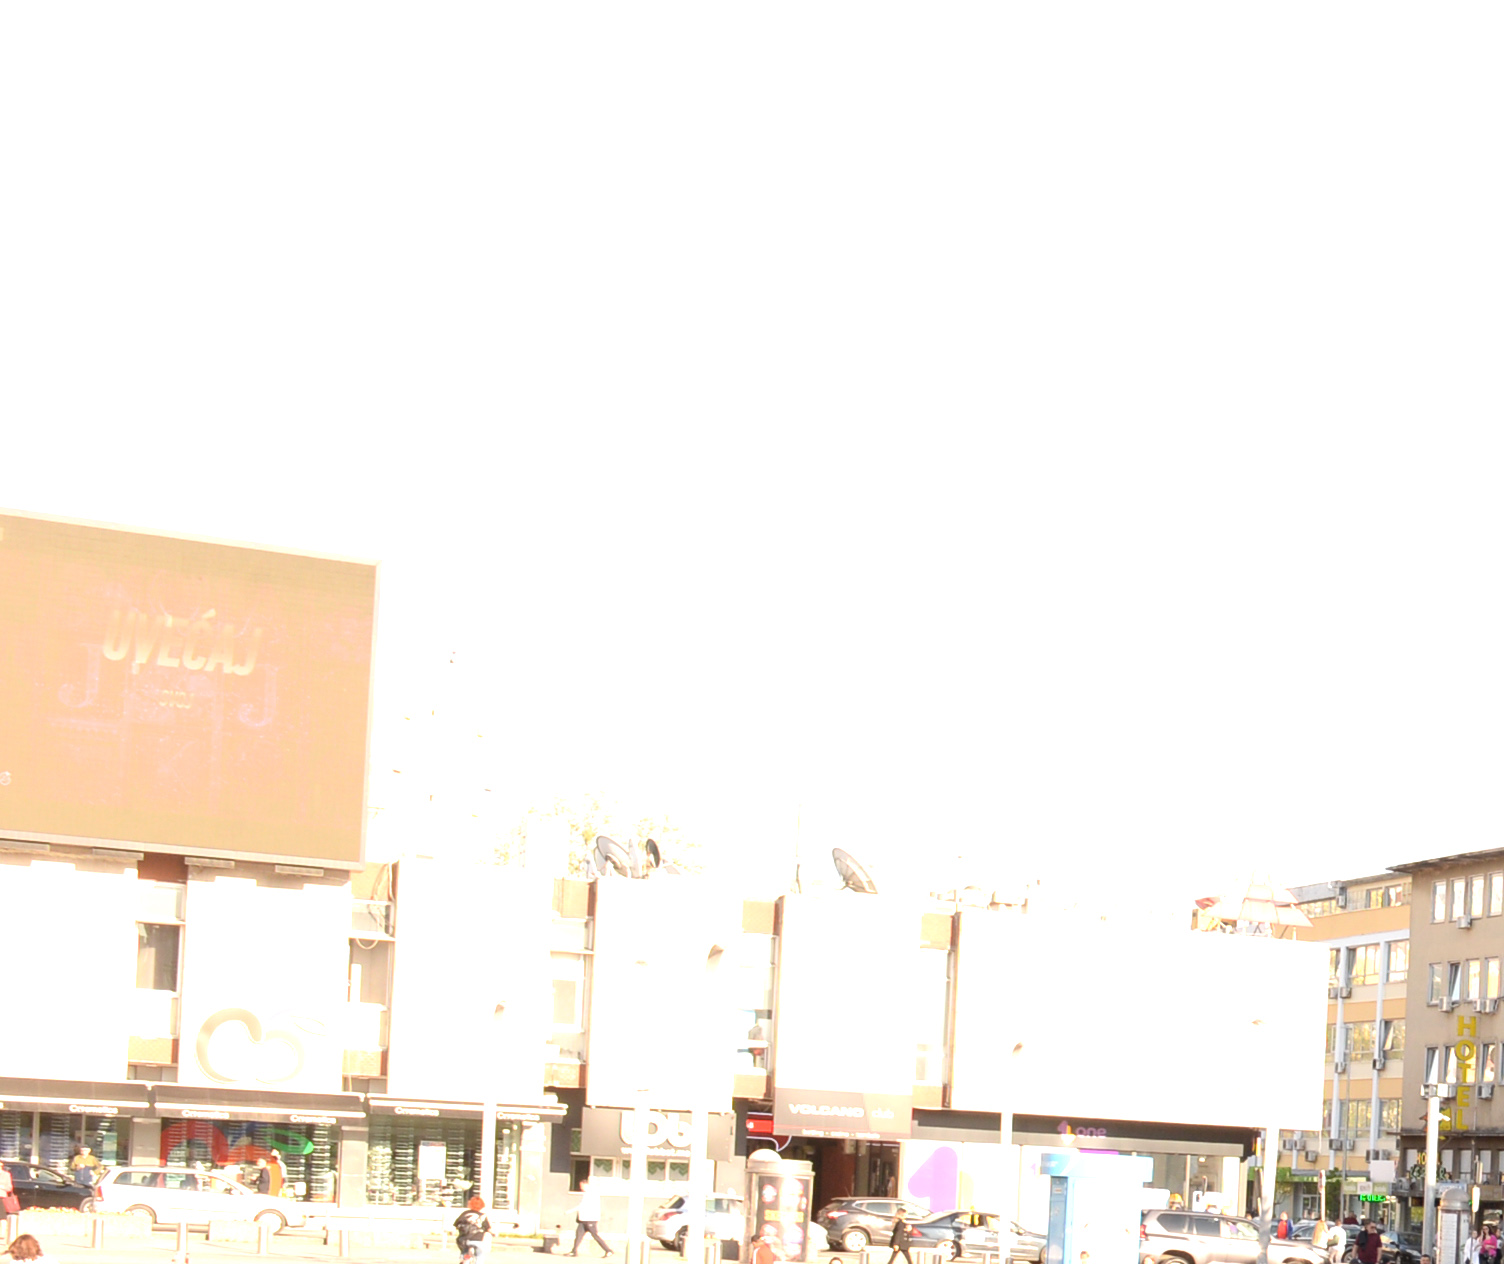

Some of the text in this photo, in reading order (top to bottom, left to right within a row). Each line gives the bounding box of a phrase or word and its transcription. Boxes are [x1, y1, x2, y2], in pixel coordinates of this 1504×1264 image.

[101, 607, 263, 676] UVEĆAJ
[1455, 1015, 1477, 1130] HOTEL
[789, 1103, 865, 1118] VOLCANO
[1075, 1126, 1107, 1138] one
